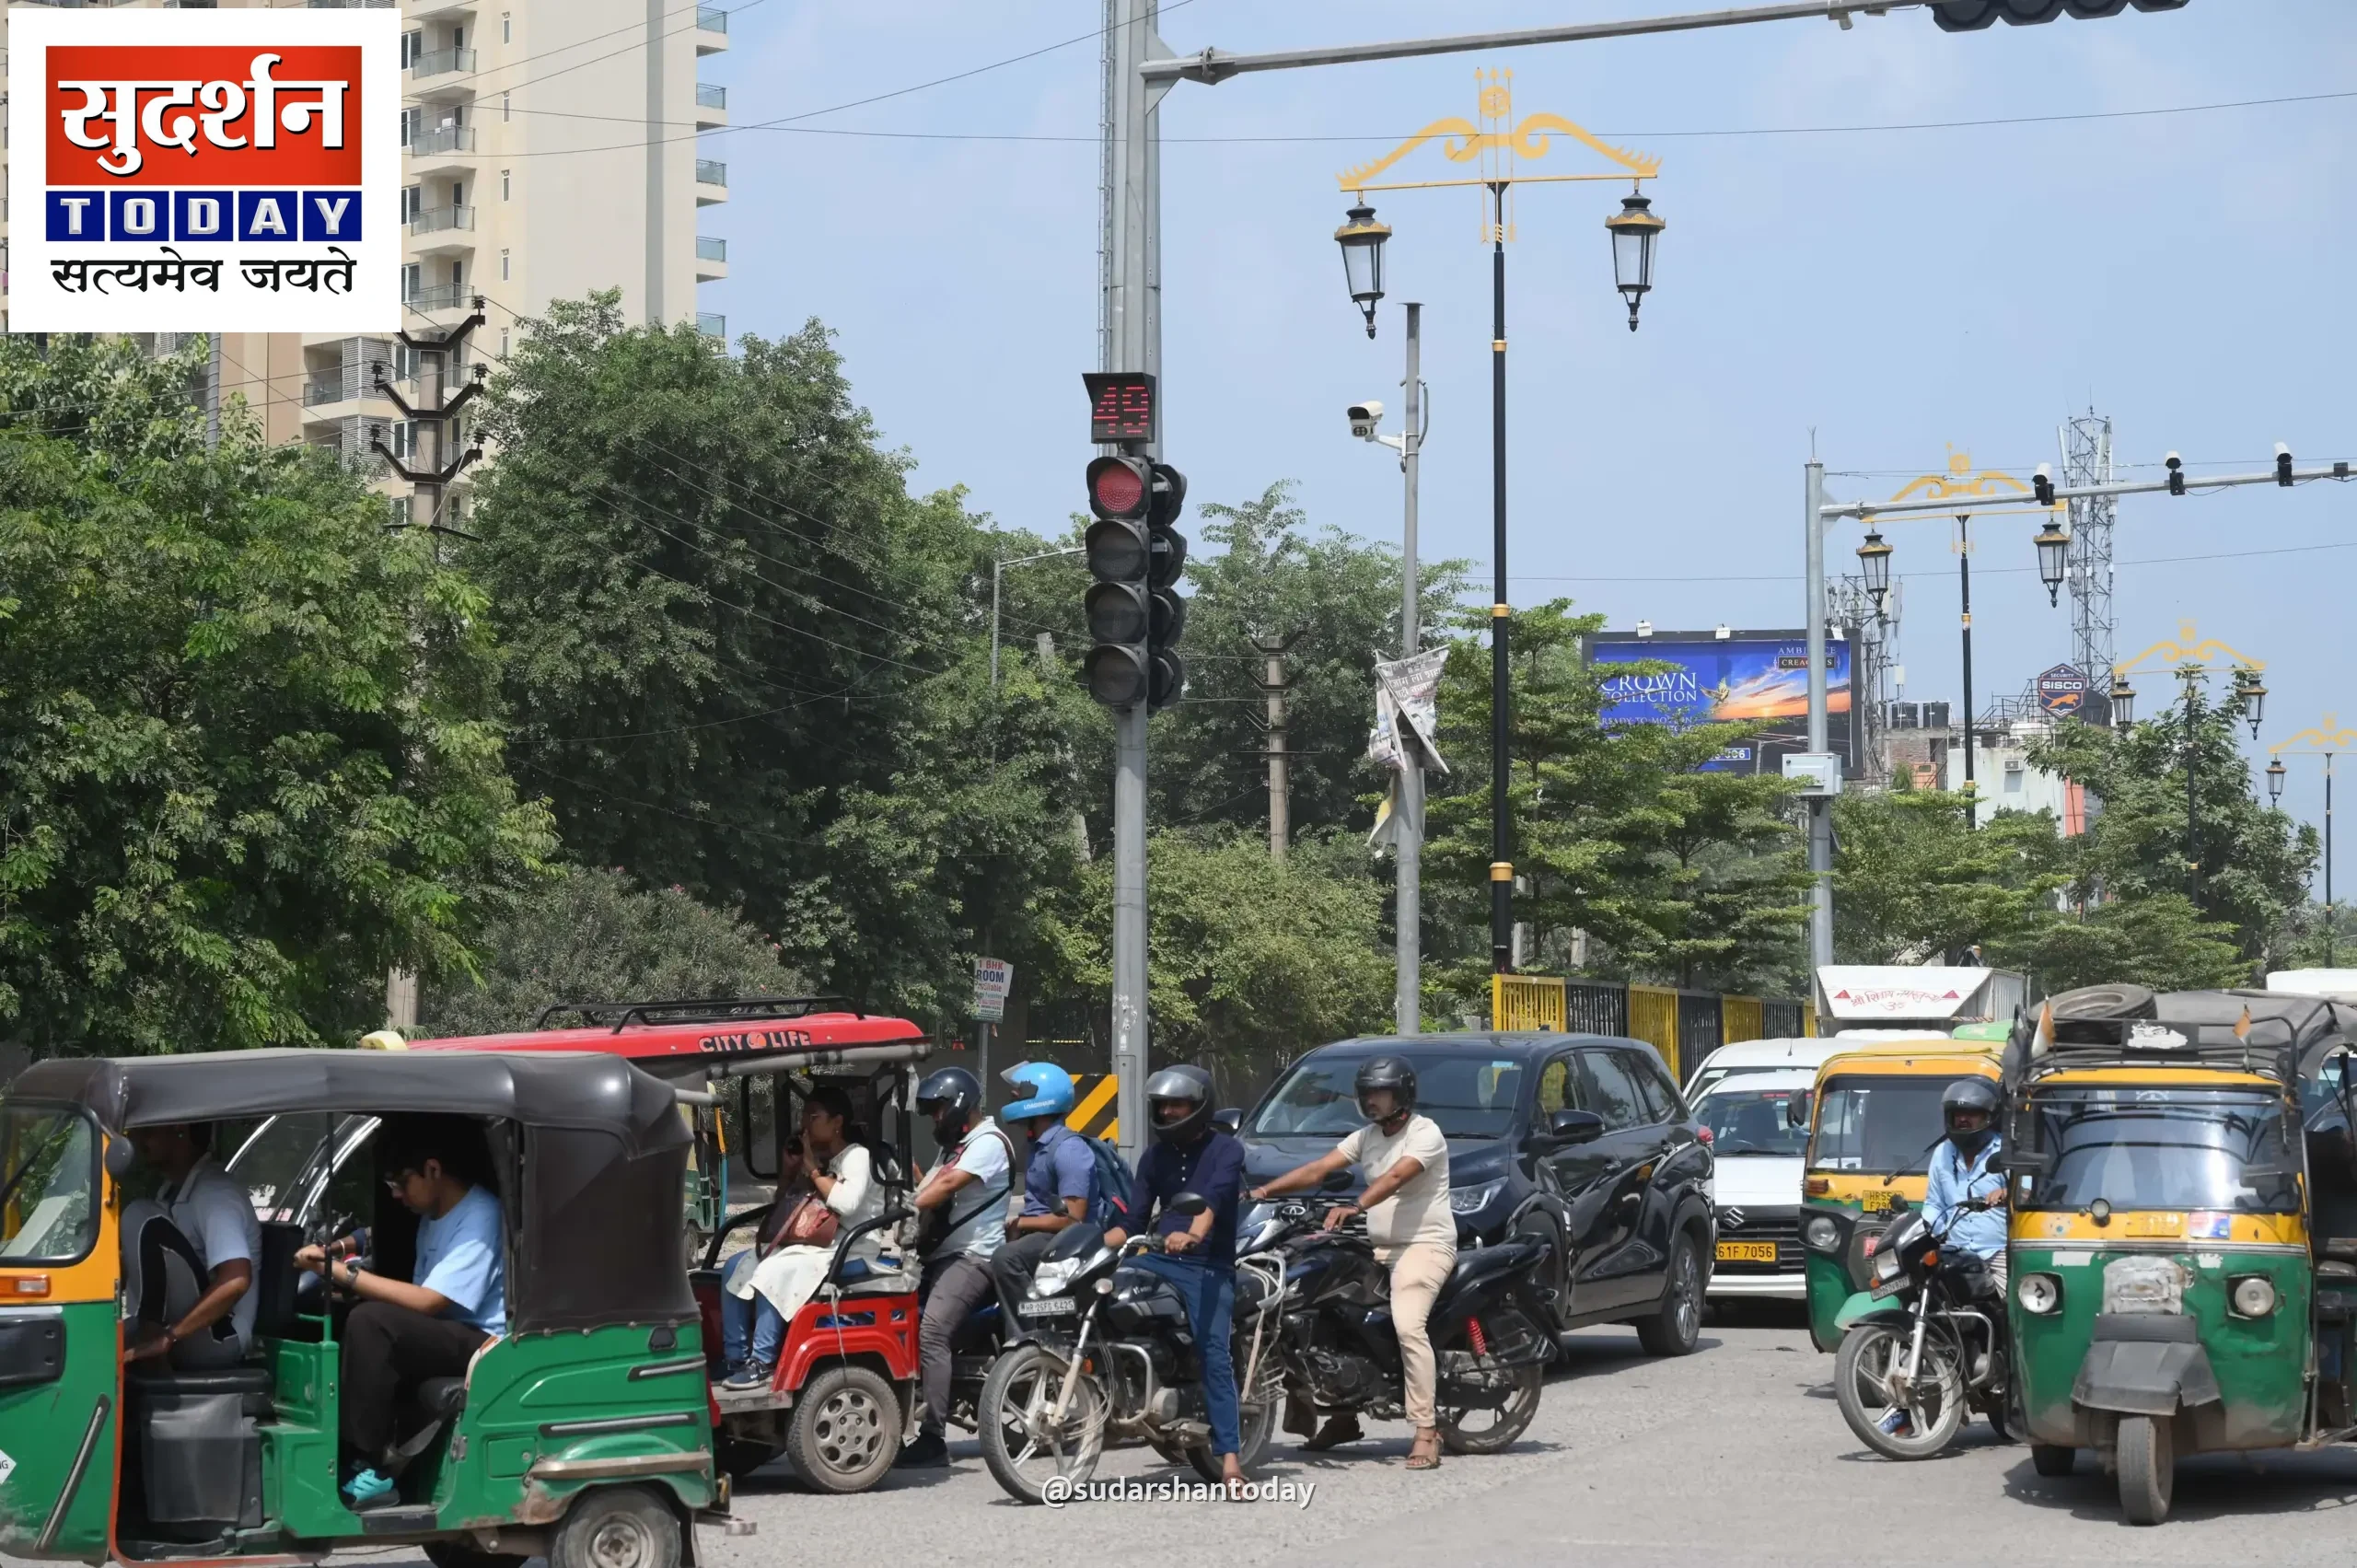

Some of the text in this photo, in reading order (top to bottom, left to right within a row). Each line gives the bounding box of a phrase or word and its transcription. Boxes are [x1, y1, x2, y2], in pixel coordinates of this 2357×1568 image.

[1782, 658, 1832, 667] CREAS
[2041, 680, 2083, 690] SISCO
[986, 960, 1004, 970] BHK
[977, 970, 1004, 983] ROOM
[698, 1030, 811, 1052] CITY LIFE
[1743, 1246, 1772, 1258] 7056
